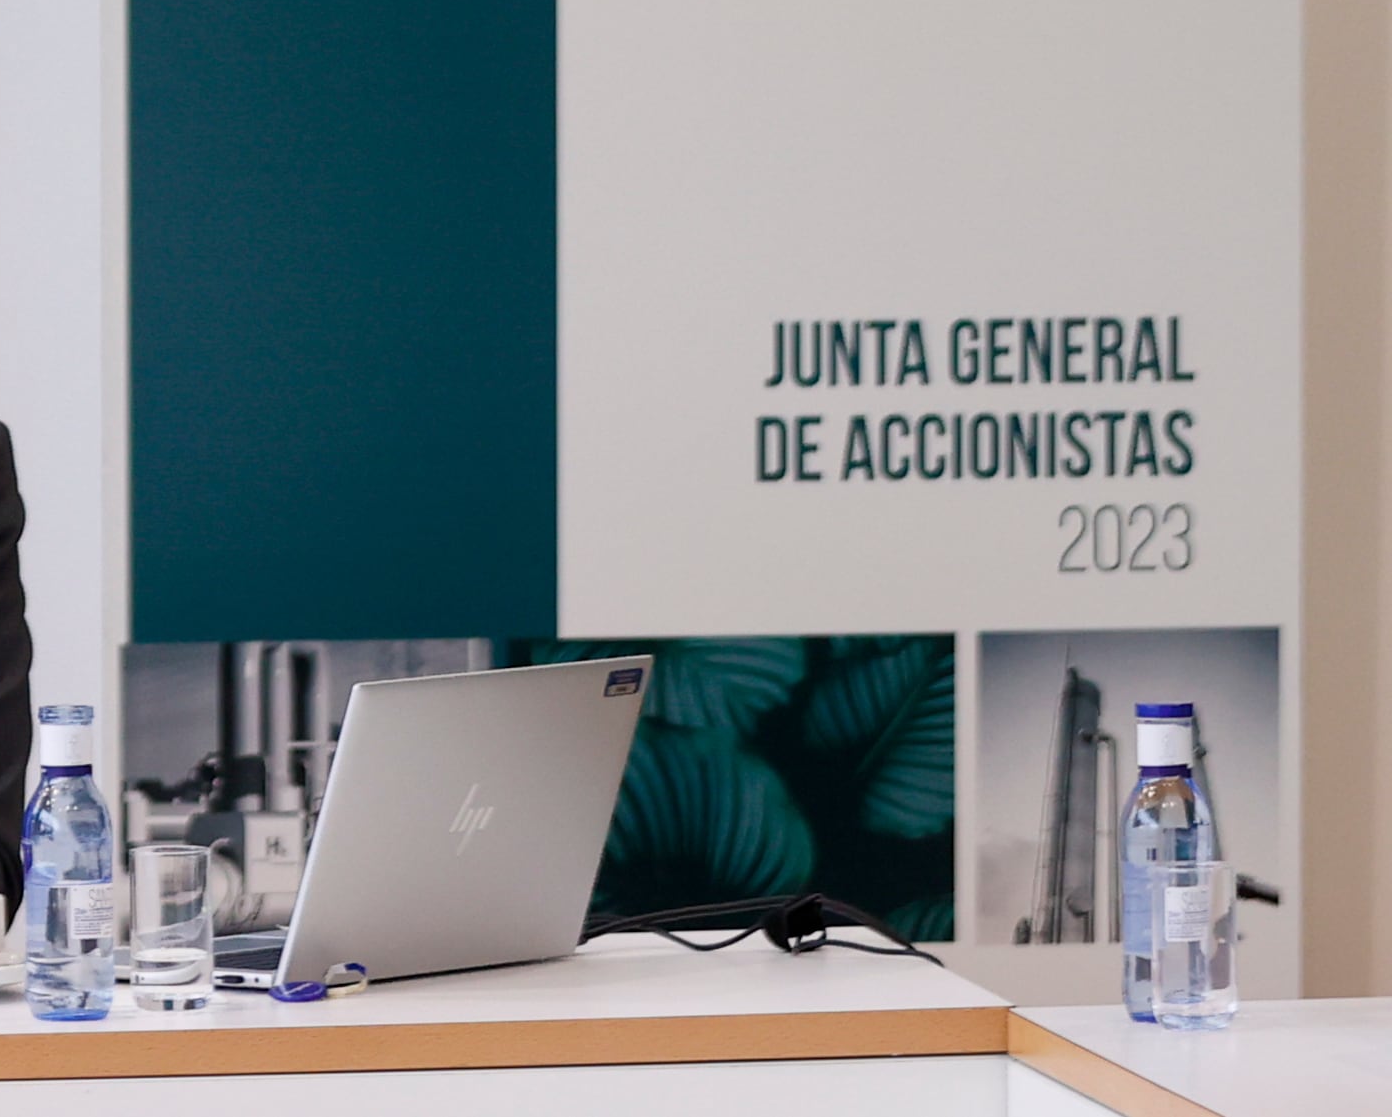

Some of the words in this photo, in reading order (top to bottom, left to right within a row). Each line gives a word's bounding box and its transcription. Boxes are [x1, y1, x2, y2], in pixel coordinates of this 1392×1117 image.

[764, 319, 931, 388] JUNTA
[949, 316, 1195, 386] GENERAL
[755, 414, 823, 483] DE
[841, 410, 1195, 481] ACCIONISTAS
[1058, 502, 1193, 573] 2023
[448, 783, 495, 856] hp
